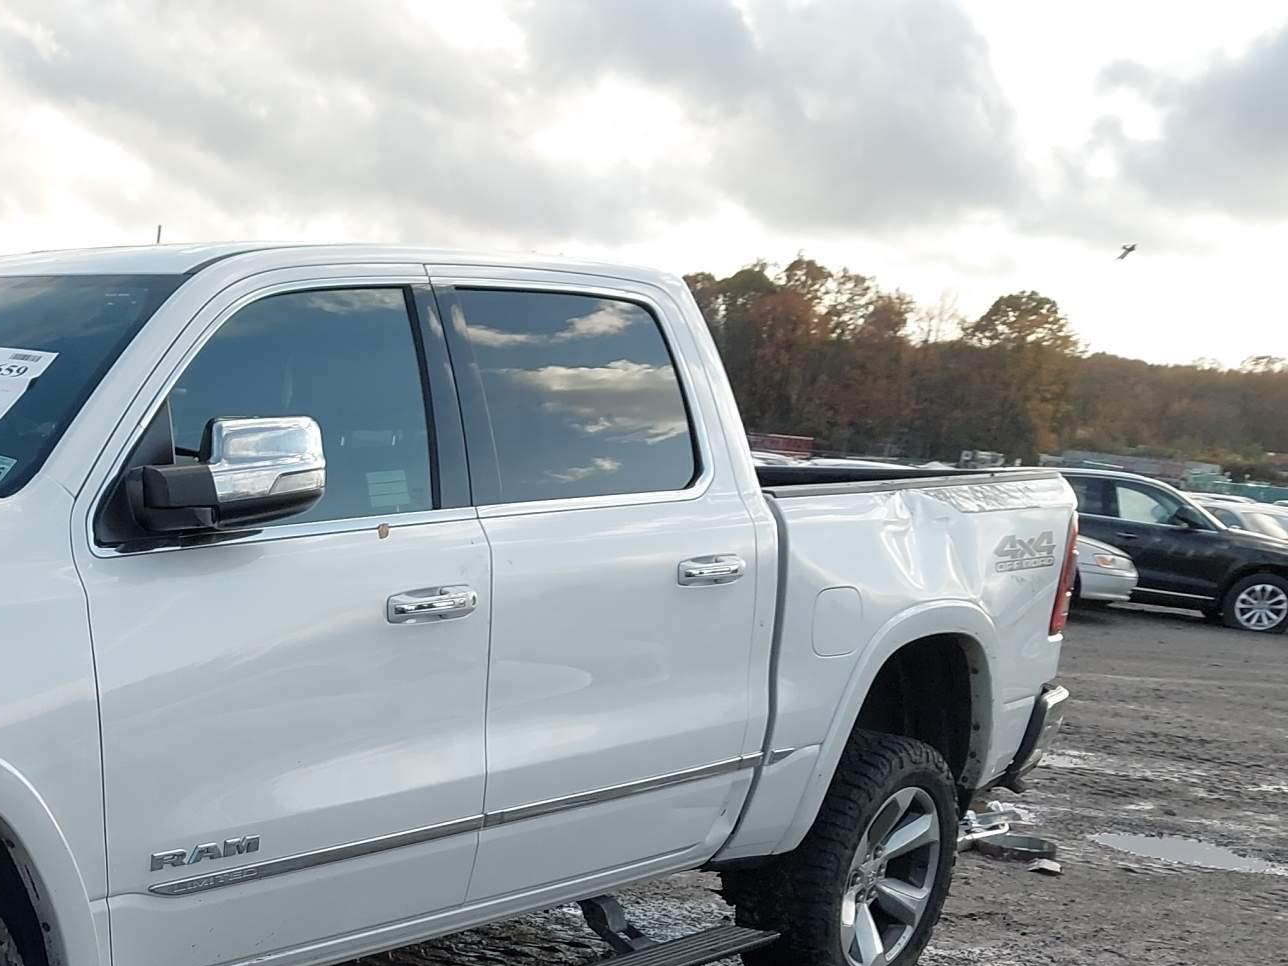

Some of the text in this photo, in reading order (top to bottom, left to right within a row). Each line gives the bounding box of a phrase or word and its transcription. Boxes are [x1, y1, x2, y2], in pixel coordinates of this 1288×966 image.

[995, 531, 1056, 559] 4x4
[150, 834, 261, 872] RAM
[173, 869, 258, 893] LIMITED
